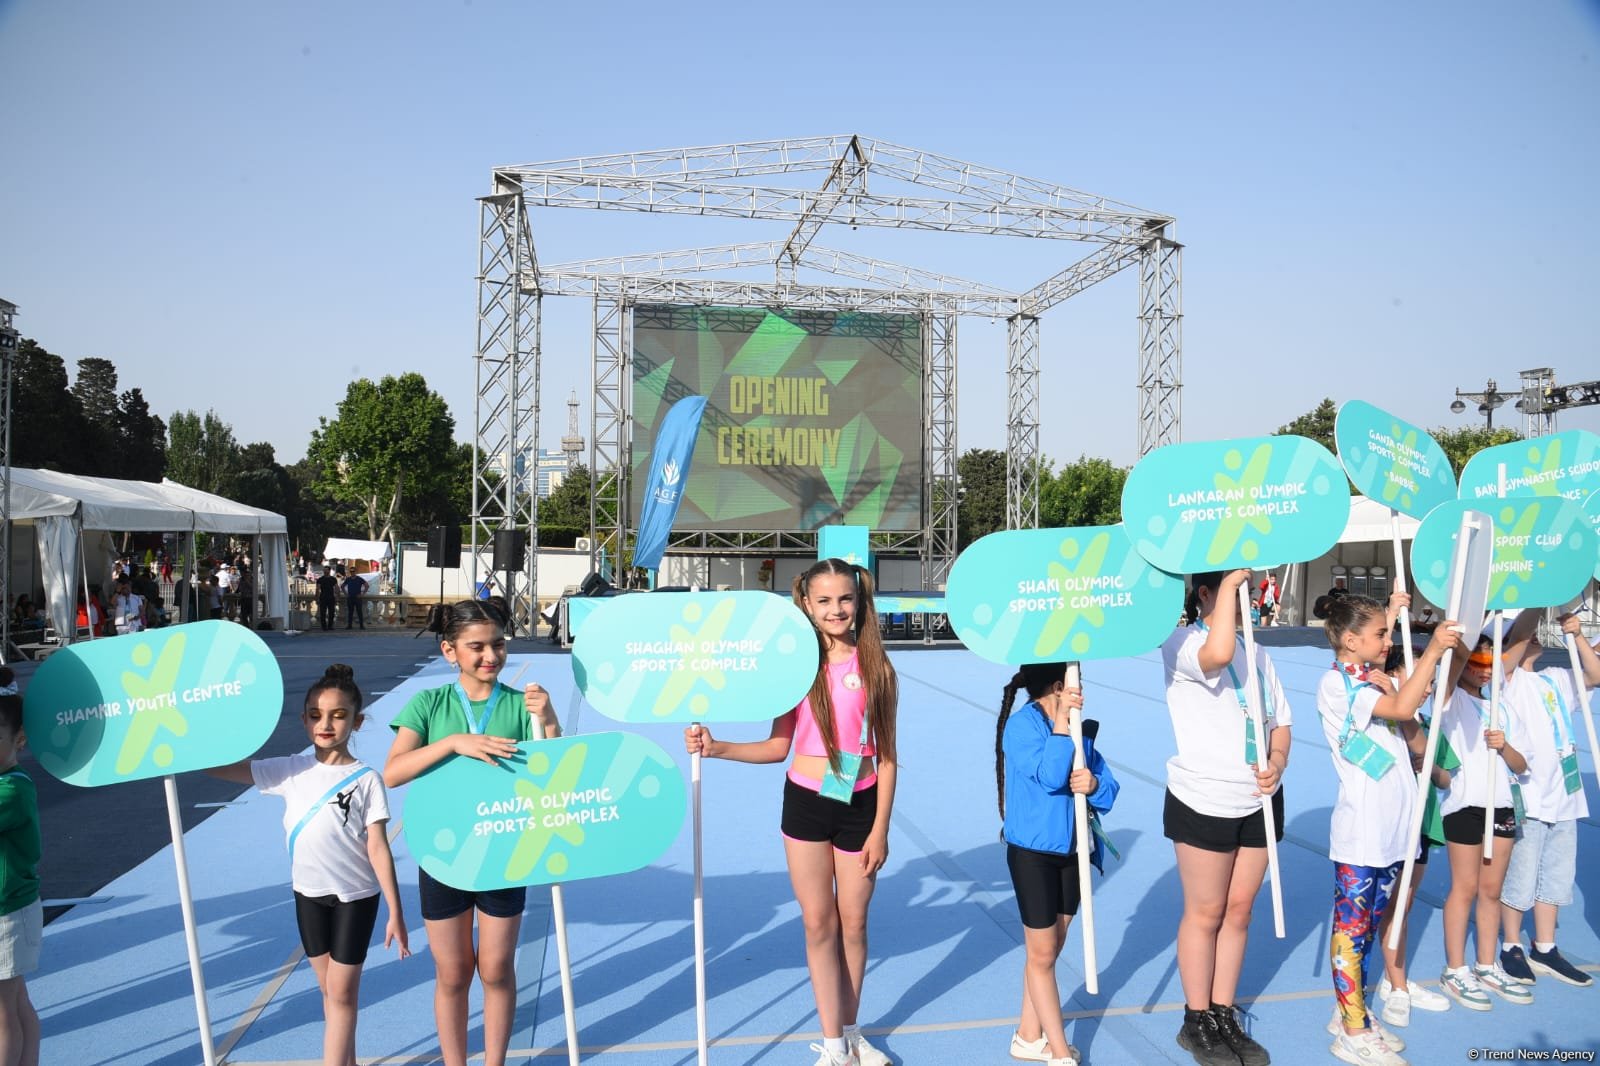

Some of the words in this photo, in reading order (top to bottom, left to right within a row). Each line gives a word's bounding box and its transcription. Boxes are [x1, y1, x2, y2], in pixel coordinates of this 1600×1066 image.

[730, 375, 829, 416] OPENING
[717, 426, 841, 467] CEREMONY
[1369, 429, 1396, 449] GANJA
[1396, 442, 1428, 465] OLYMPIC
[1367, 441, 1396, 462] SPORTS
[1397, 455, 1431, 479] COMPLEX
[1504, 468, 1566, 491] GYMNASTICS
[1168, 487, 1245, 507] LANKARAN
[1249, 482, 1307, 499] OLYMPIC
[1180, 506, 1233, 523] SPORTS
[1237, 500, 1300, 518] COMPLEX
[1495, 535, 1532, 547] SPORT
[1535, 533, 1562, 545] CLUB
[1018, 578, 1060, 594] SHAKI
[1064, 576, 1124, 592] OLYMPIC
[1009, 597, 1065, 613] SPORTS
[1070, 592, 1133, 609] COMPLEX
[625, 640, 695, 655] SHAGHAN
[701, 639, 764, 654] OLYMPIC
[631, 658, 686, 672] SPORTS
[690, 657, 758, 672] COMPLEX
[55, 702, 122, 726] SHAMKIR
[126, 691, 177, 715] YOUTH
[182, 680, 242, 704] CENTRE
[476, 796, 535, 817] GANJA
[541, 788, 613, 809] OLYMPIC
[474, 816, 537, 836] SPORTS
[542, 805, 620, 828] COMPLEX
